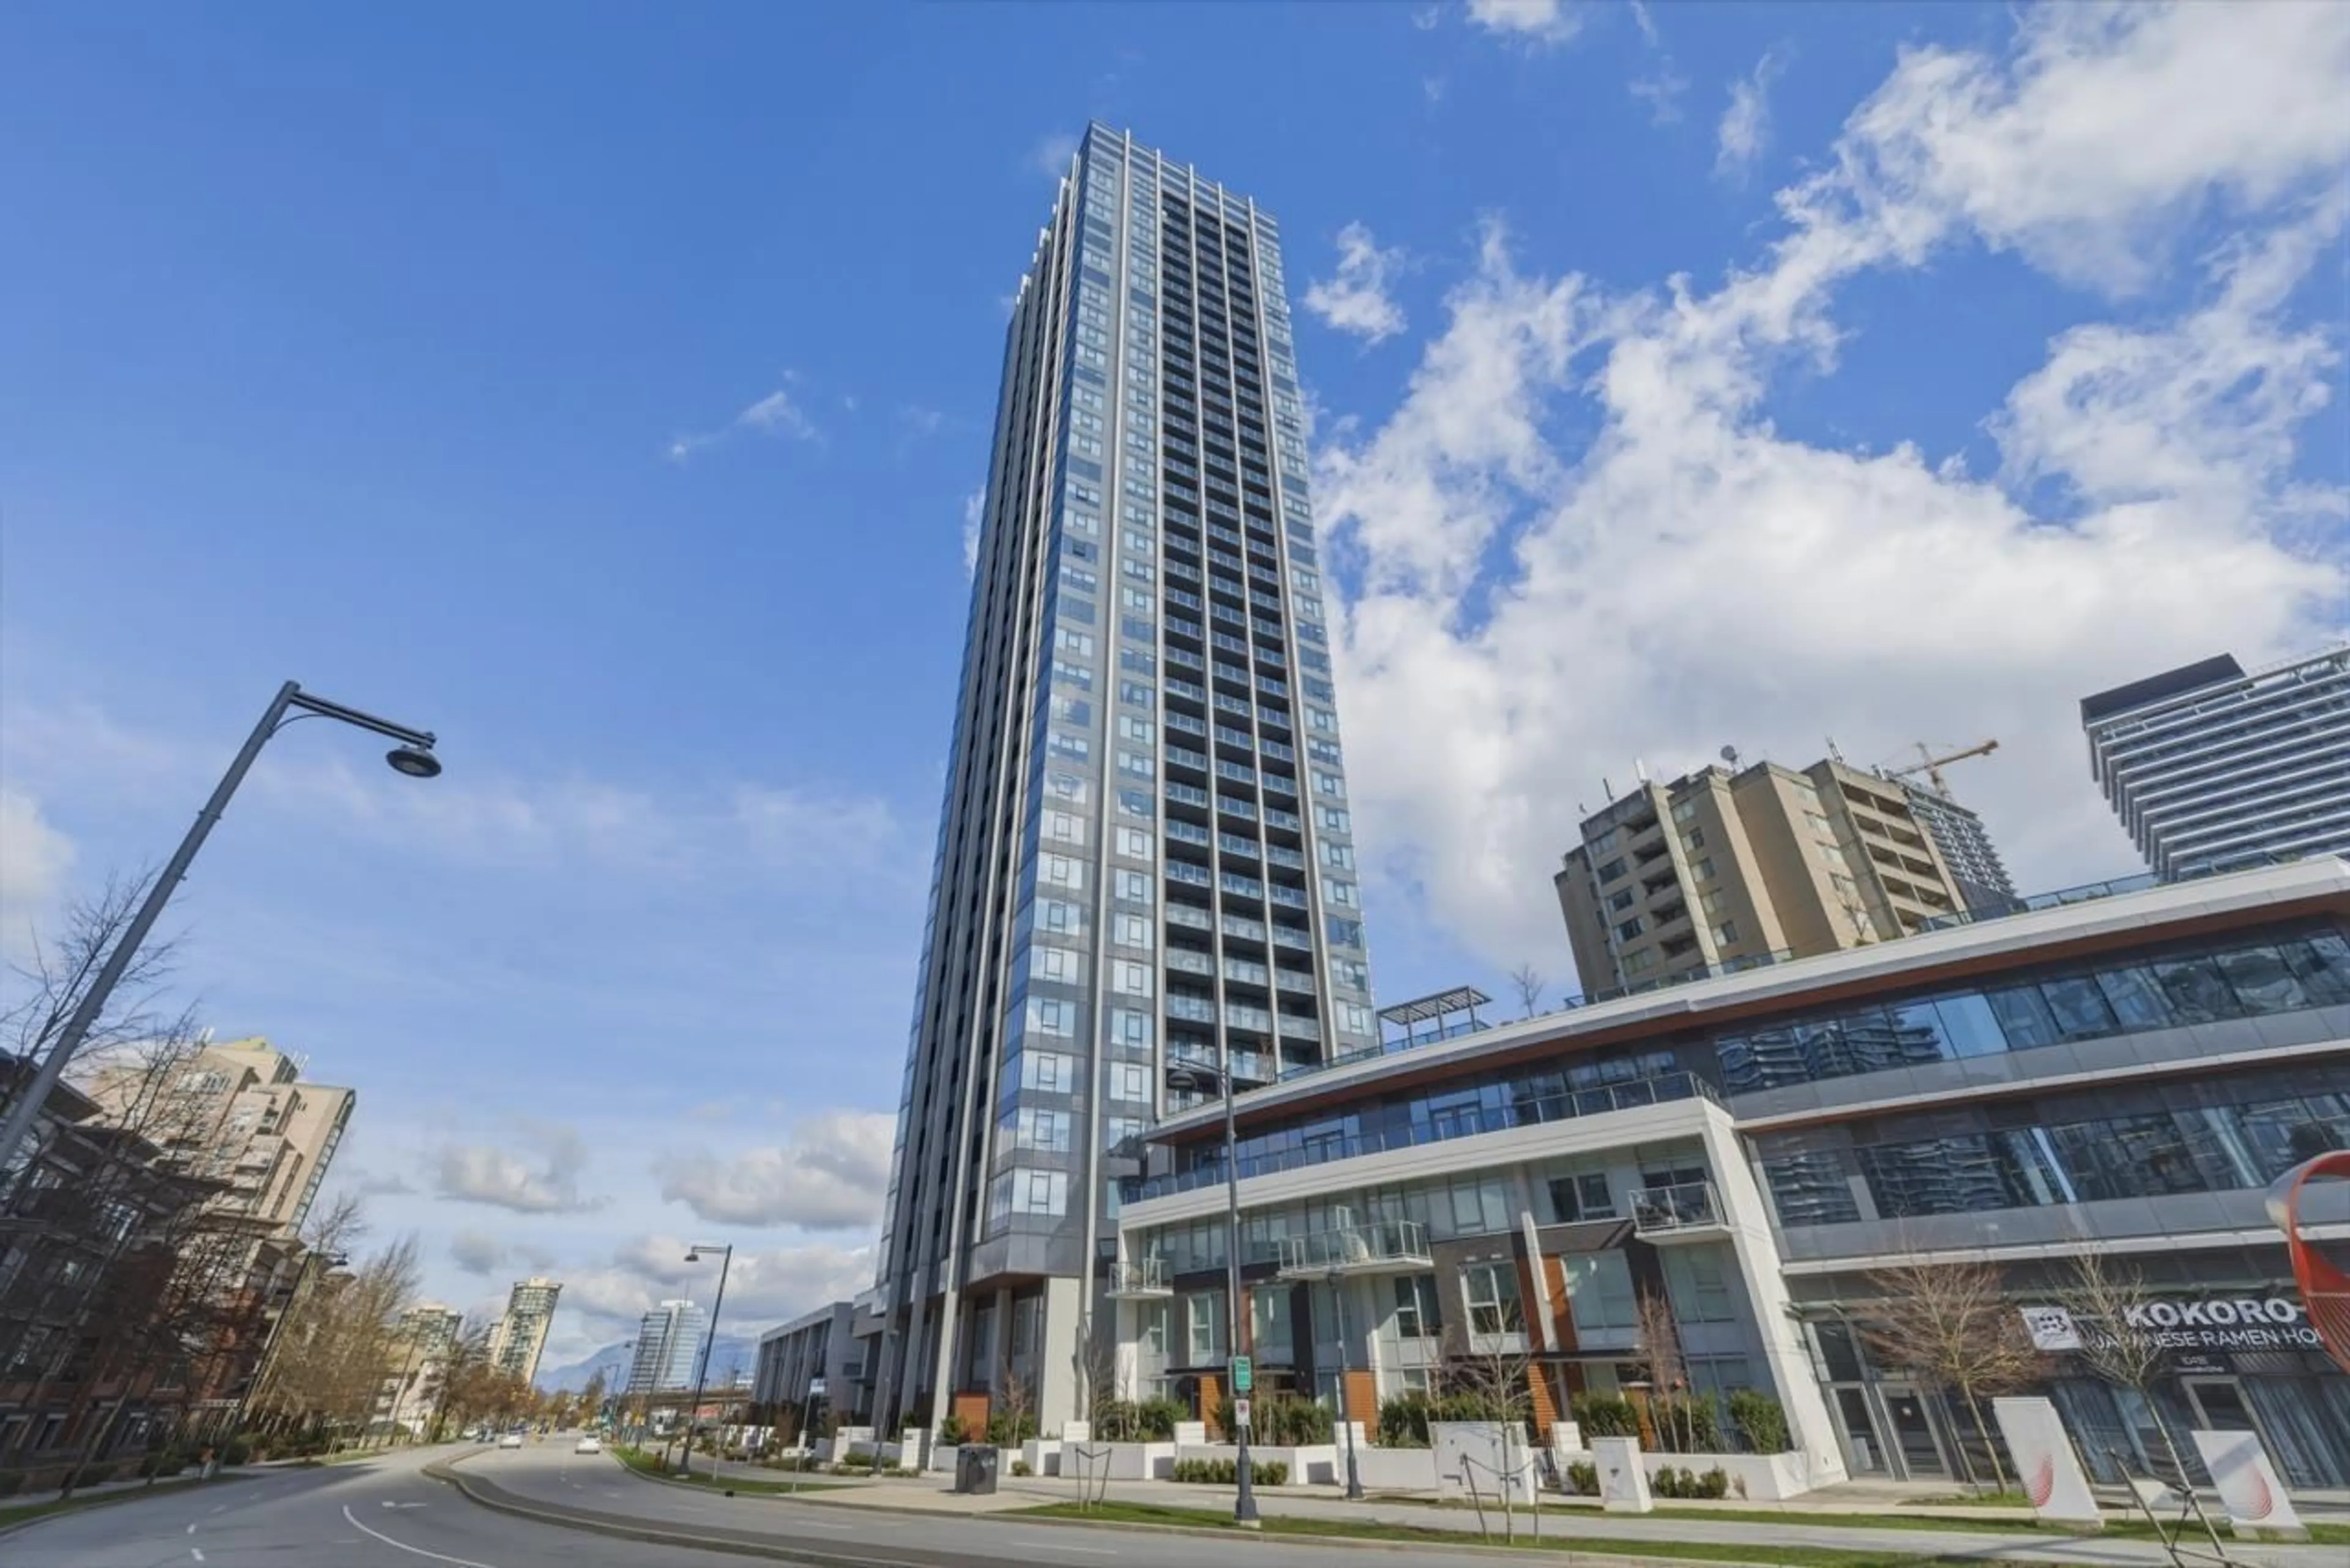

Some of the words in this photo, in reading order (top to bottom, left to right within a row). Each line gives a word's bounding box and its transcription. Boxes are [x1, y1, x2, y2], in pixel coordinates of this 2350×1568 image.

[2122, 1298, 2297, 1327] KOKORO
[2096, 1331, 2199, 1349] JANESE
[2201, 1328, 2280, 1346] RAMEN
